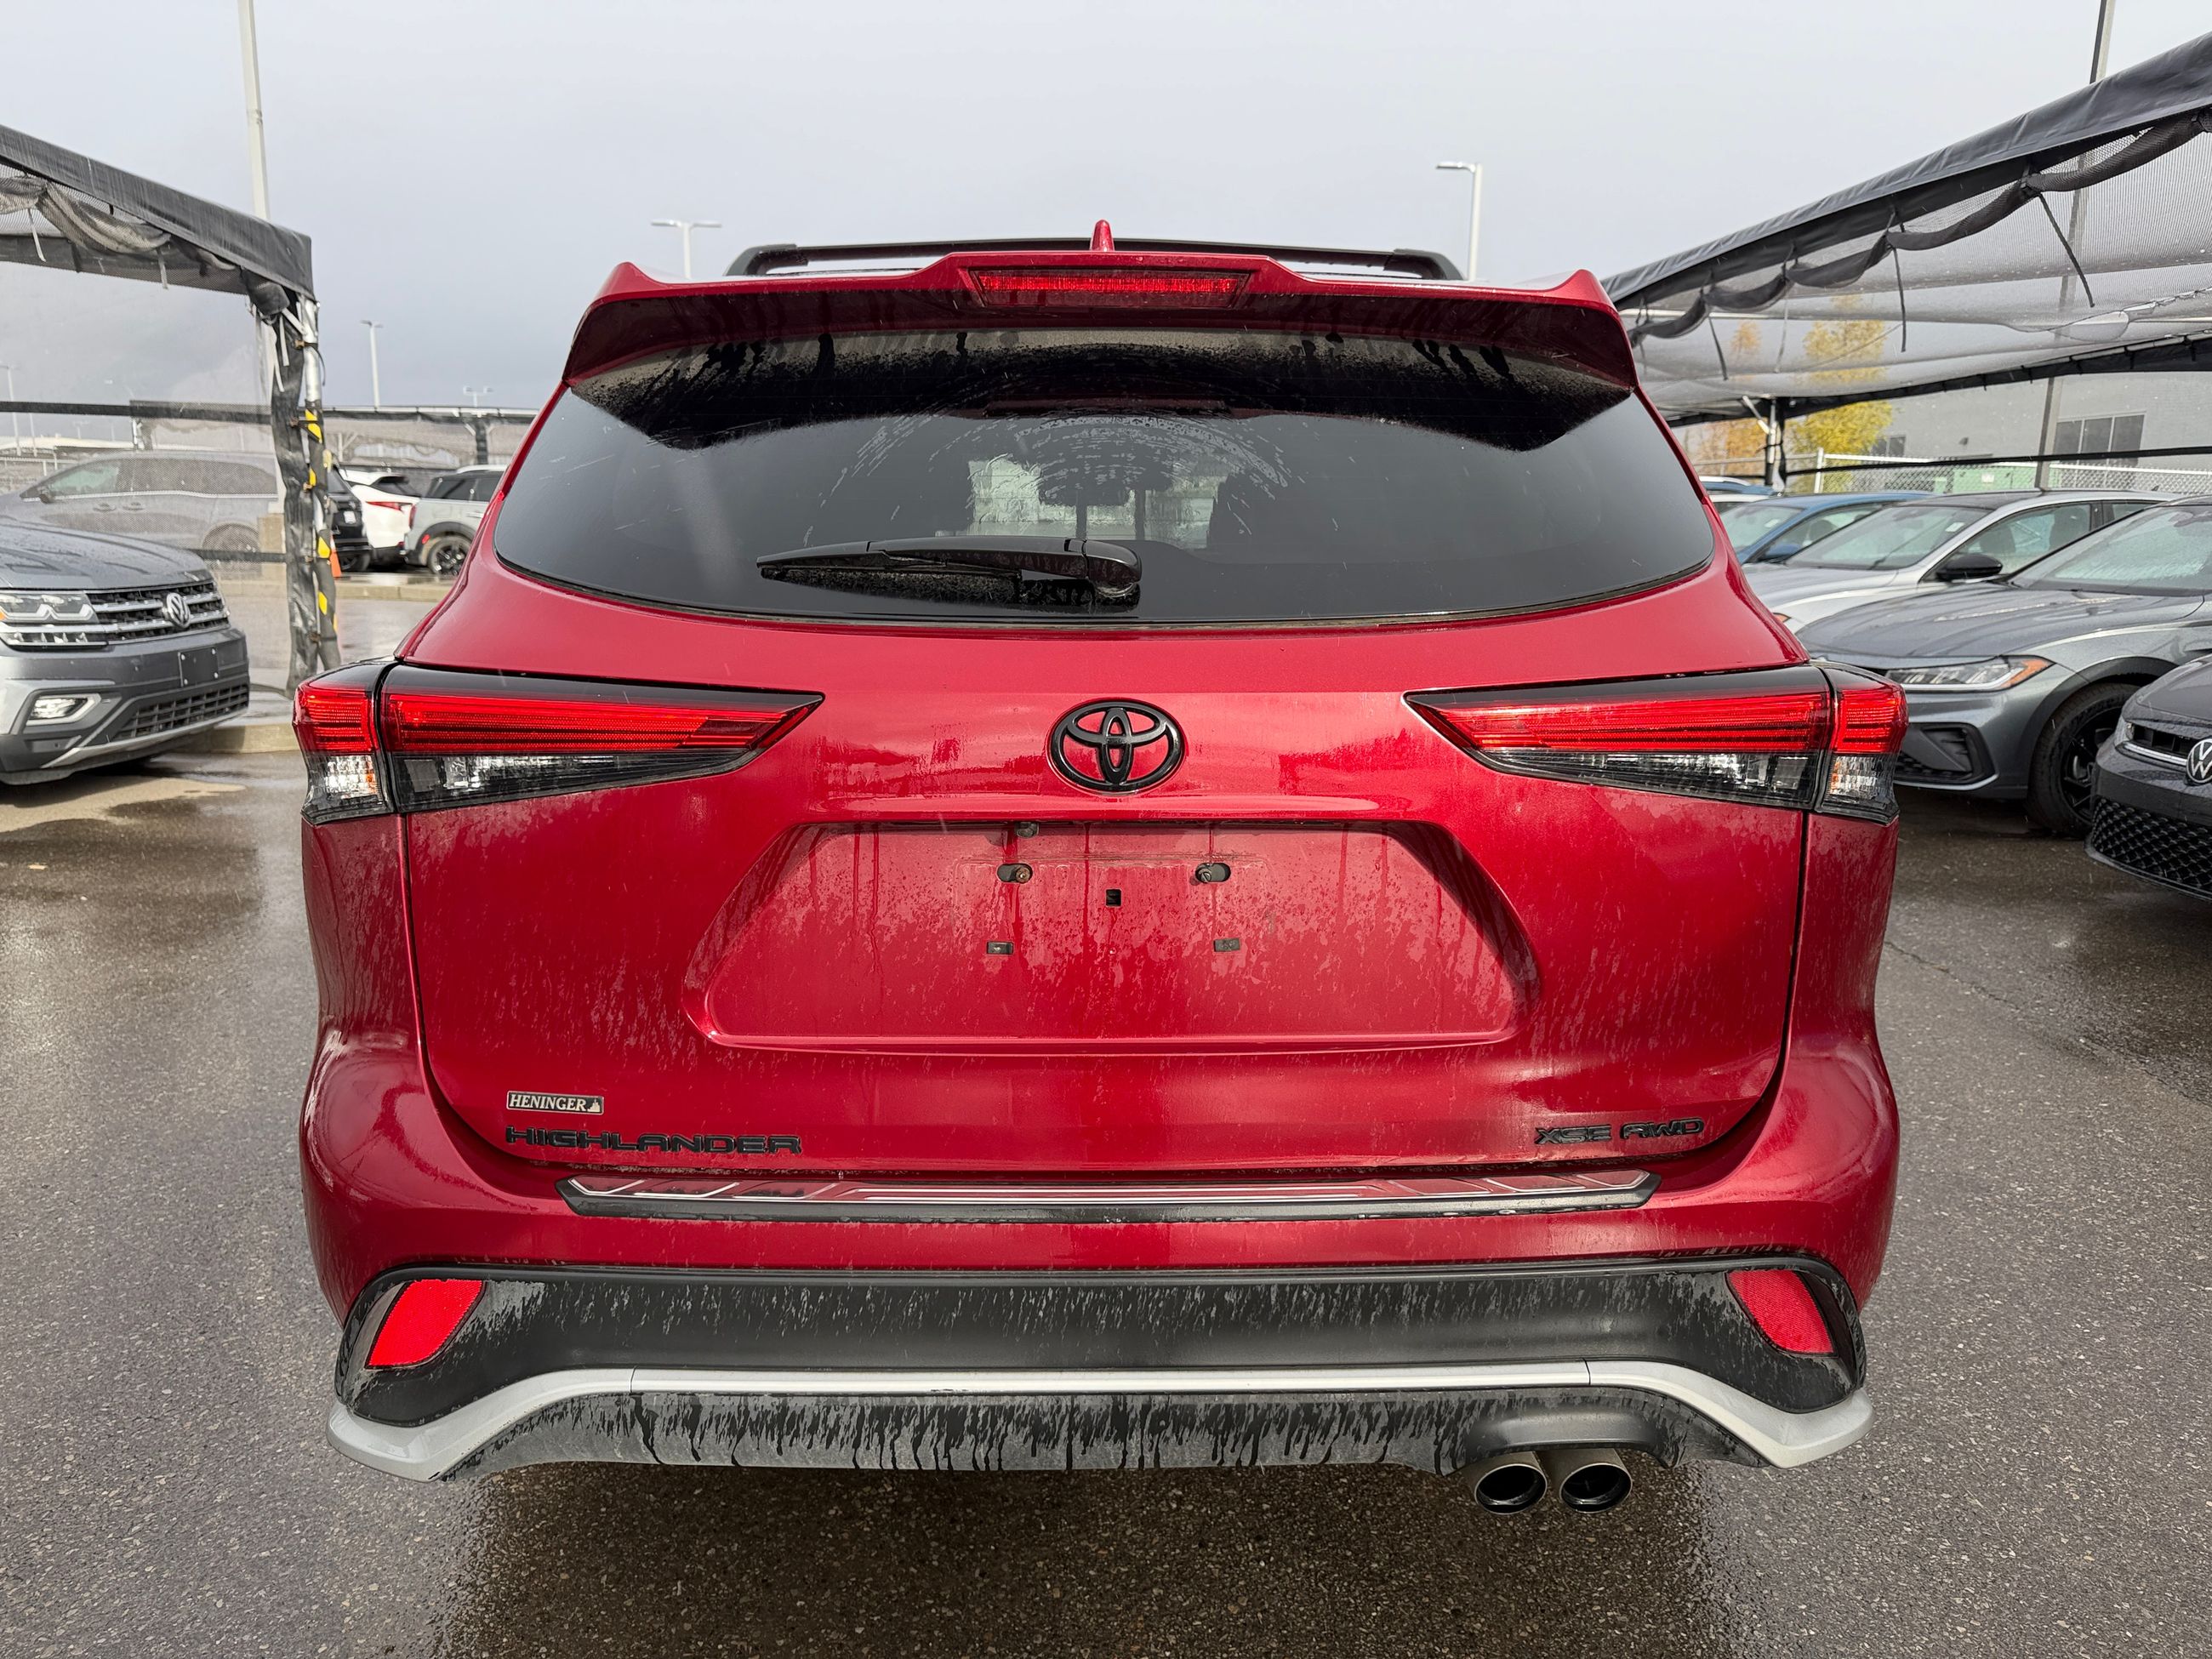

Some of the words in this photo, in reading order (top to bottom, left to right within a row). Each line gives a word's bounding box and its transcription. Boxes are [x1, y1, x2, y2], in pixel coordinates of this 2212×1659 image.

[509, 1093, 587, 1112] HENINGER
[506, 1126, 802, 1154] HIGHLANDER
[1535, 1124, 1612, 1144] XSE
[1620, 1117, 1705, 1140] AWD
